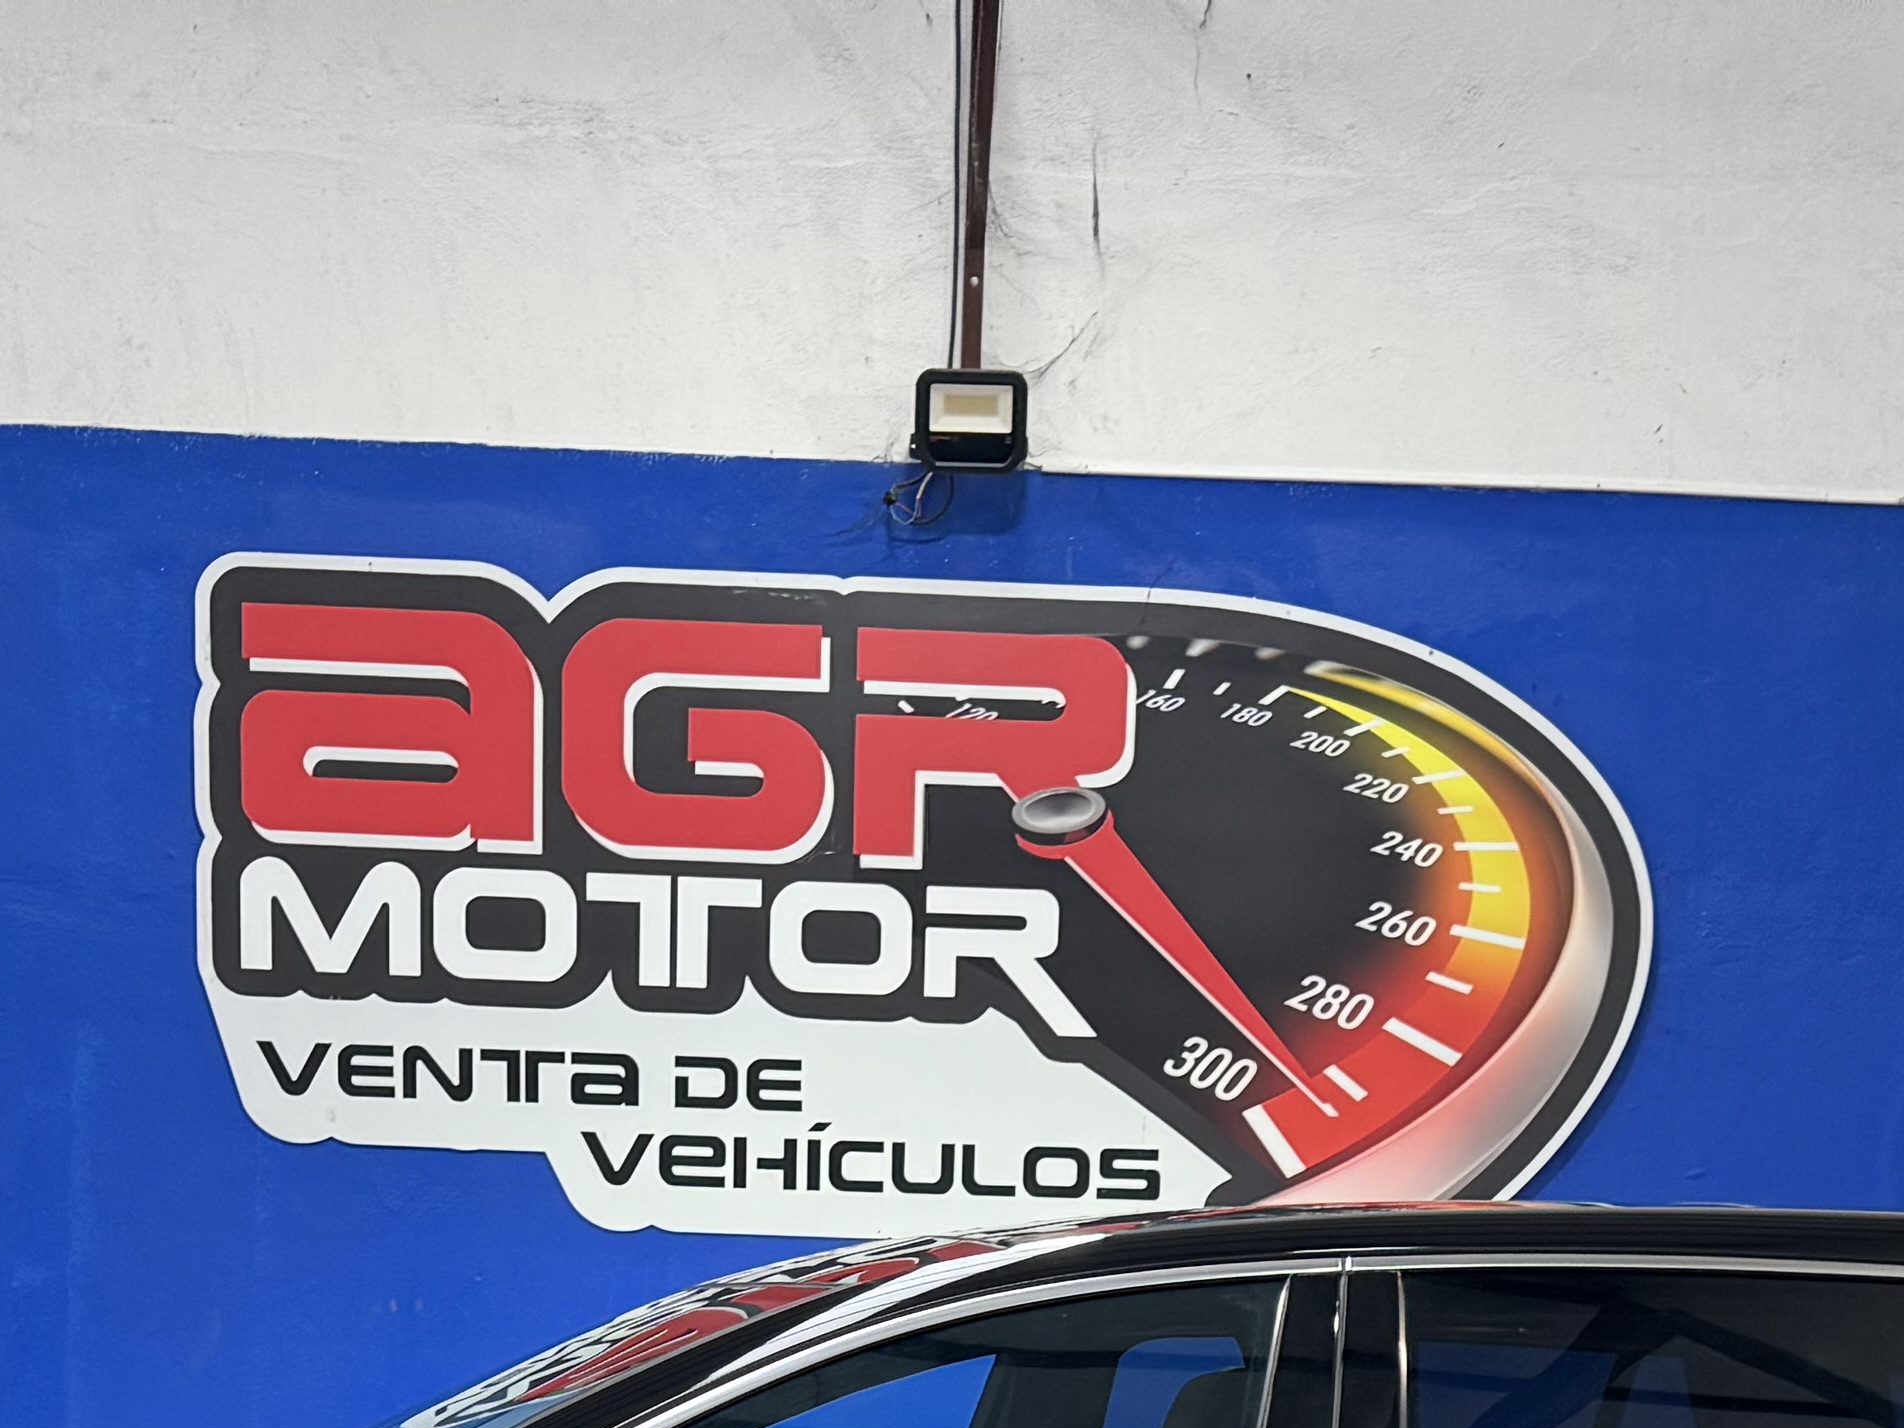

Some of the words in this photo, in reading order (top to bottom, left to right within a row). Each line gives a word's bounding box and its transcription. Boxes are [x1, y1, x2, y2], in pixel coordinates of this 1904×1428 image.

[1221, 703, 1273, 727] 180
[1290, 730, 1351, 758] 200
[1343, 772, 1410, 804] 220
[1370, 831, 1444, 868] 240
[1355, 900, 1438, 947] 260
[240, 860, 1096, 1038] MOTOR
[1283, 974, 1375, 1031] 280
[674, 1056, 805, 1112] DE
[1162, 1035, 1258, 1102] 300
